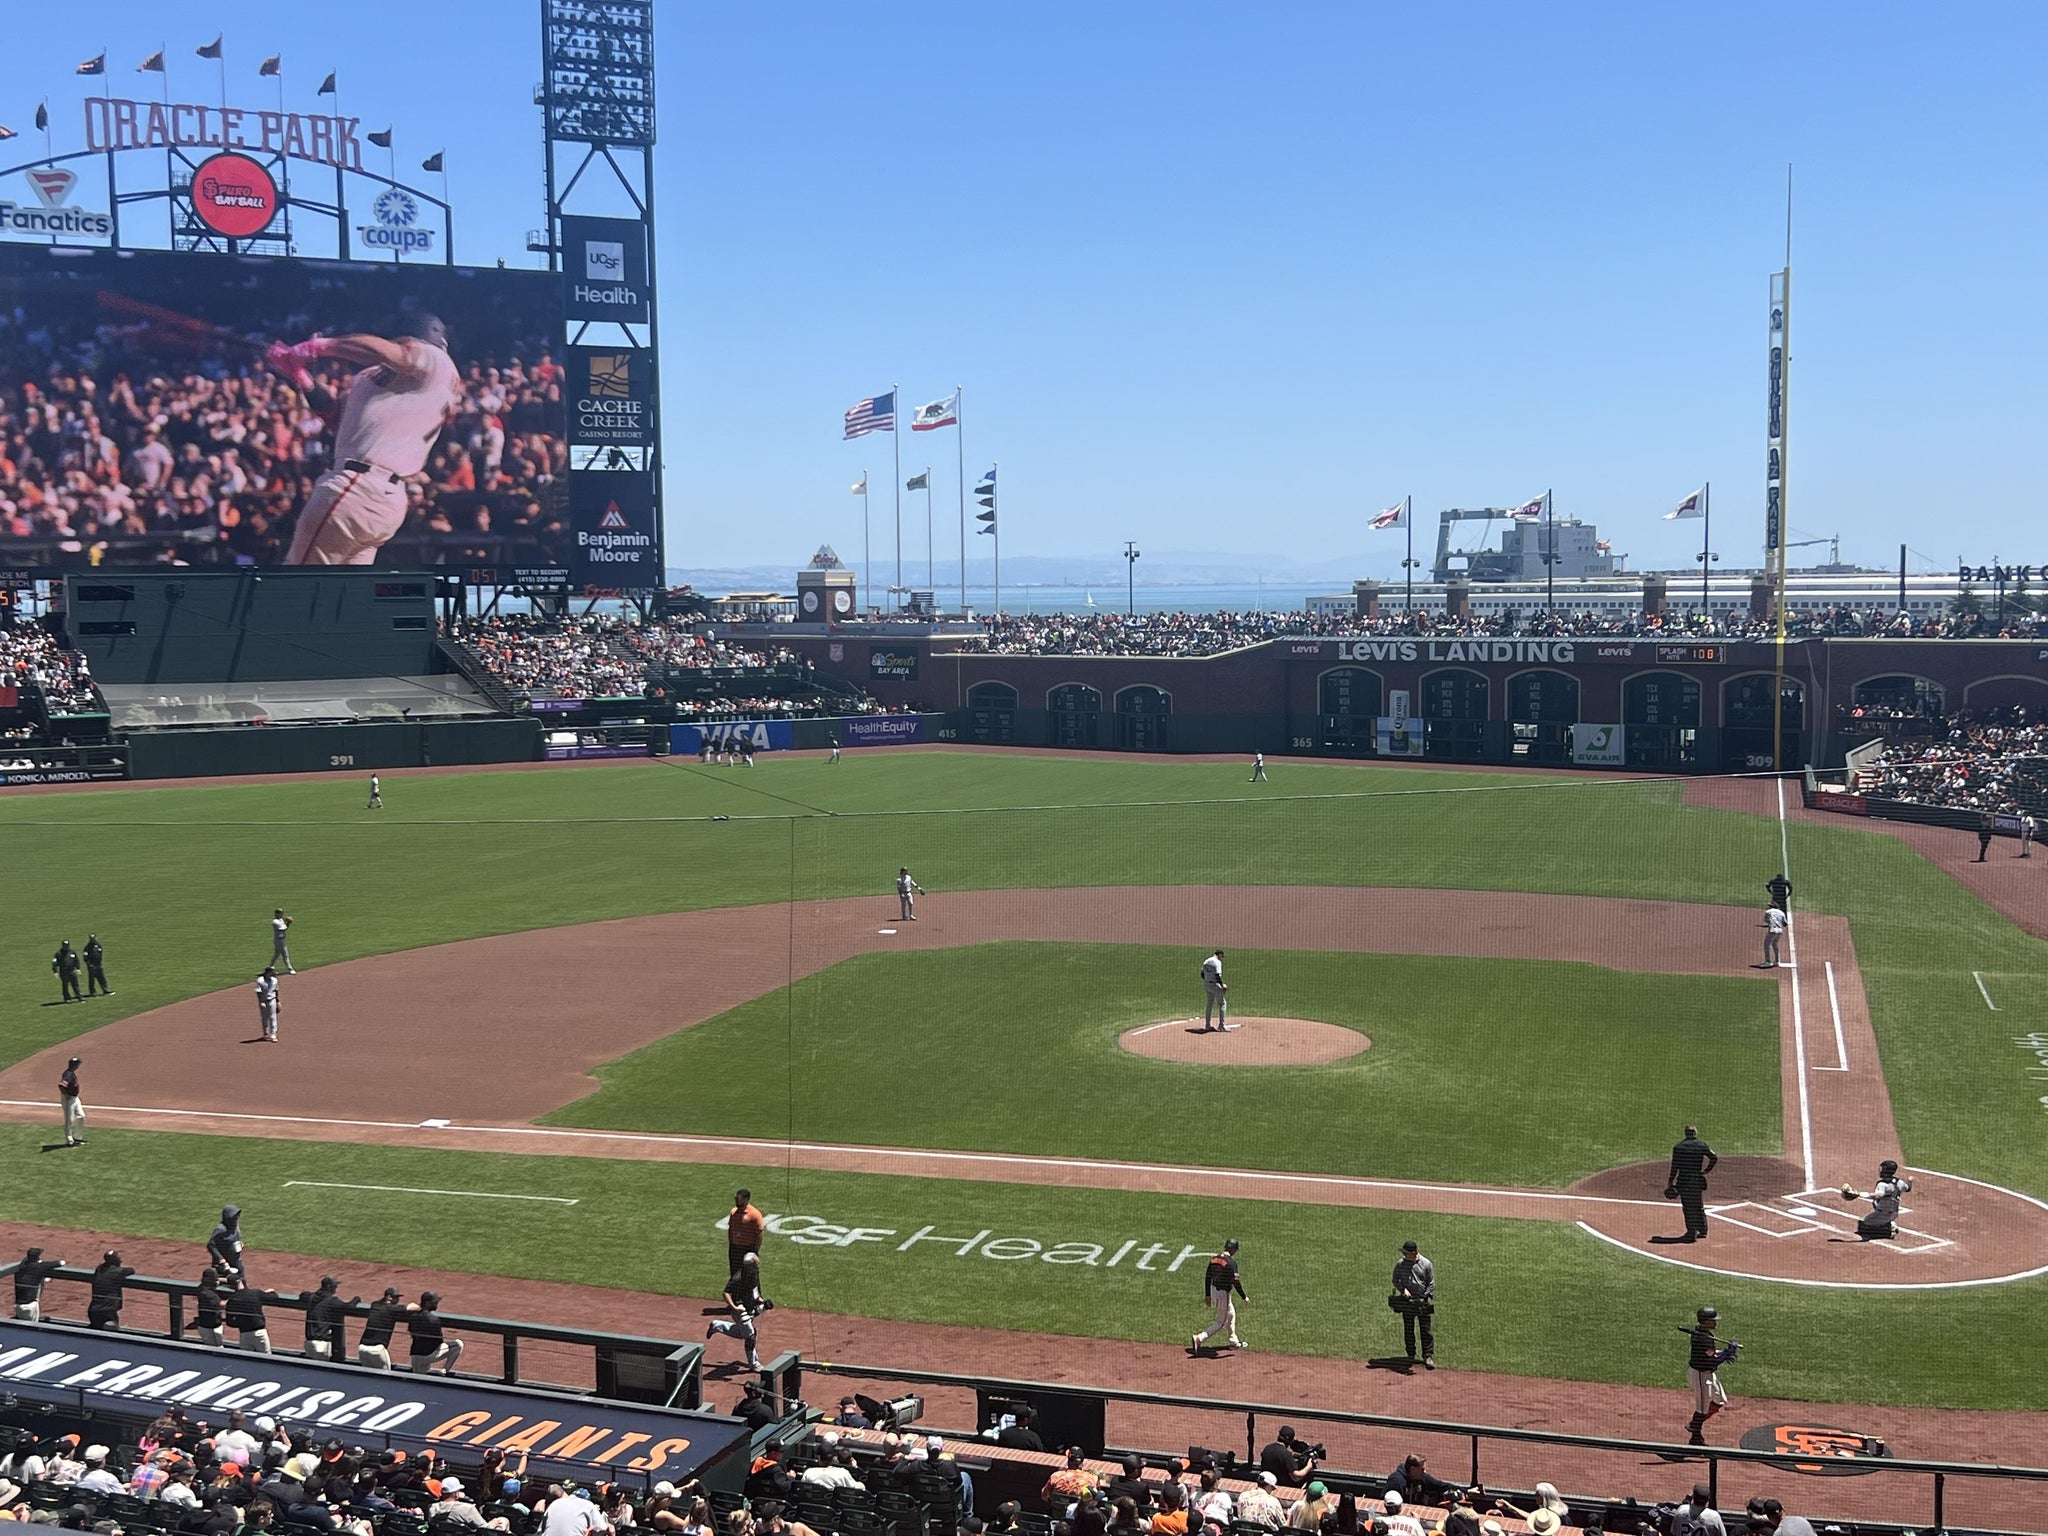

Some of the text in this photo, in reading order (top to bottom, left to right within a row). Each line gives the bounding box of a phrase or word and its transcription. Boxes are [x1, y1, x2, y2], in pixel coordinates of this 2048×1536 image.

[85, 97, 364, 172] ORACLE PARK
[0, 204, 110, 233] Fanatics
[366, 230, 429, 251] coupa
[590, 253, 620, 269] UCSF
[575, 285, 637, 304] Health
[578, 400, 642, 413] CACHE
[580, 415, 640, 428] CREEK
[578, 531, 650, 549] Benjamin
[589, 548, 640, 562] Moore
[1960, 565, 2031, 581] BANK
[1428, 642, 1575, 663] LANDING
[1659, 647, 1687, 655] SPLASH
[885, 652, 916, 667] Sports
[877, 667, 910, 675] BAY AREA
[849, 721, 918, 734] HealthEquity
[938, 729, 957, 739] 415
[692, 724, 771, 751] VISA
[1292, 738, 1312, 748] 365
[330, 755, 354, 766] 391
[1746, 755, 1774, 767] 309
[7, 771, 91, 784] KONICA MINOLTA
[0, 1343, 691, 1471] AN FRANCISCO GIANTS
